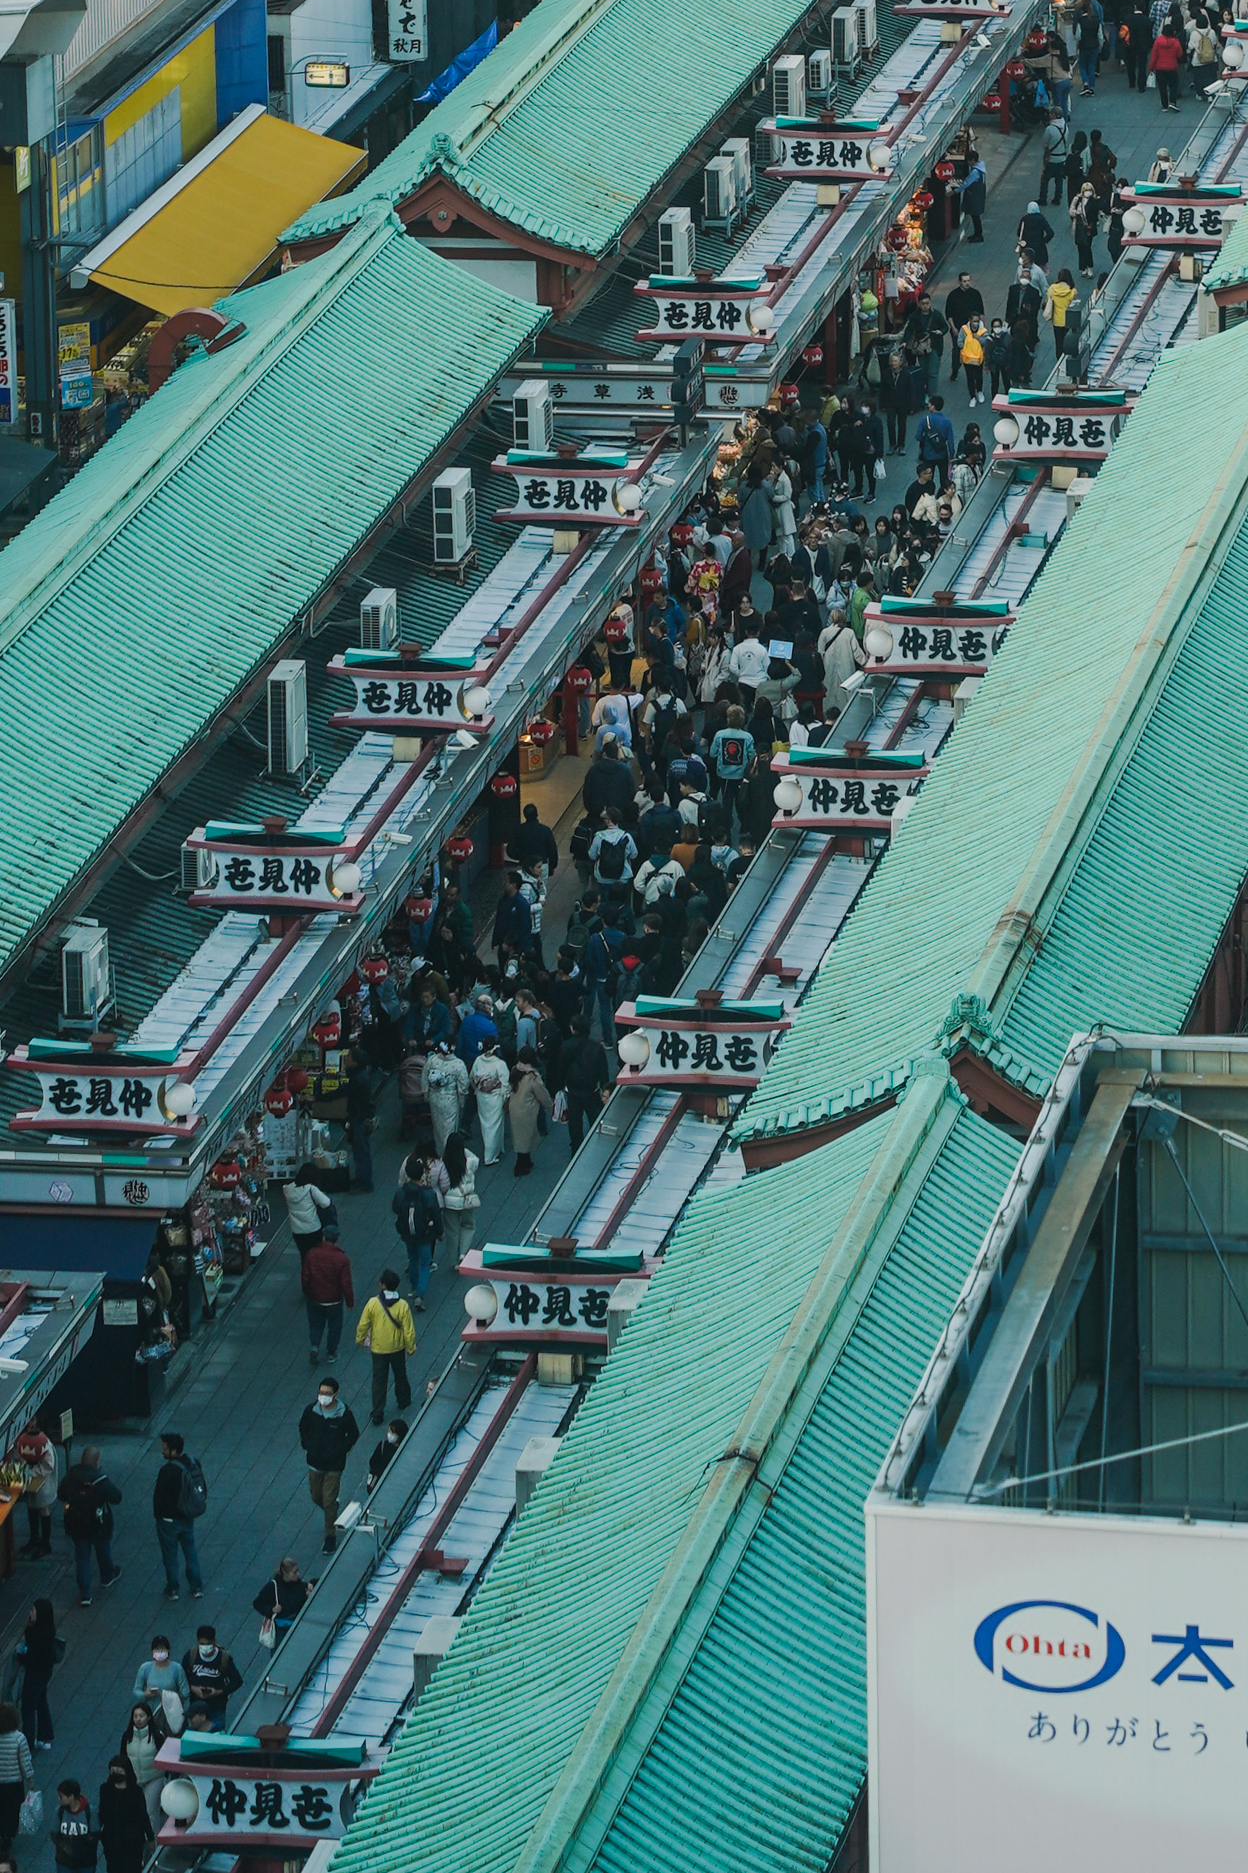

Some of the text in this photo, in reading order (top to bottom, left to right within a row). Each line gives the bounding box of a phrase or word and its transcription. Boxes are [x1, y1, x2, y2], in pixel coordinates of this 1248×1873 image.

[393, 38, 421, 54] 秋月
[1005, 1634, 1092, 1660] Ohta
[1028, 1711, 1212, 1756] ありがとう
[60, 1820, 88, 1836] GAP
